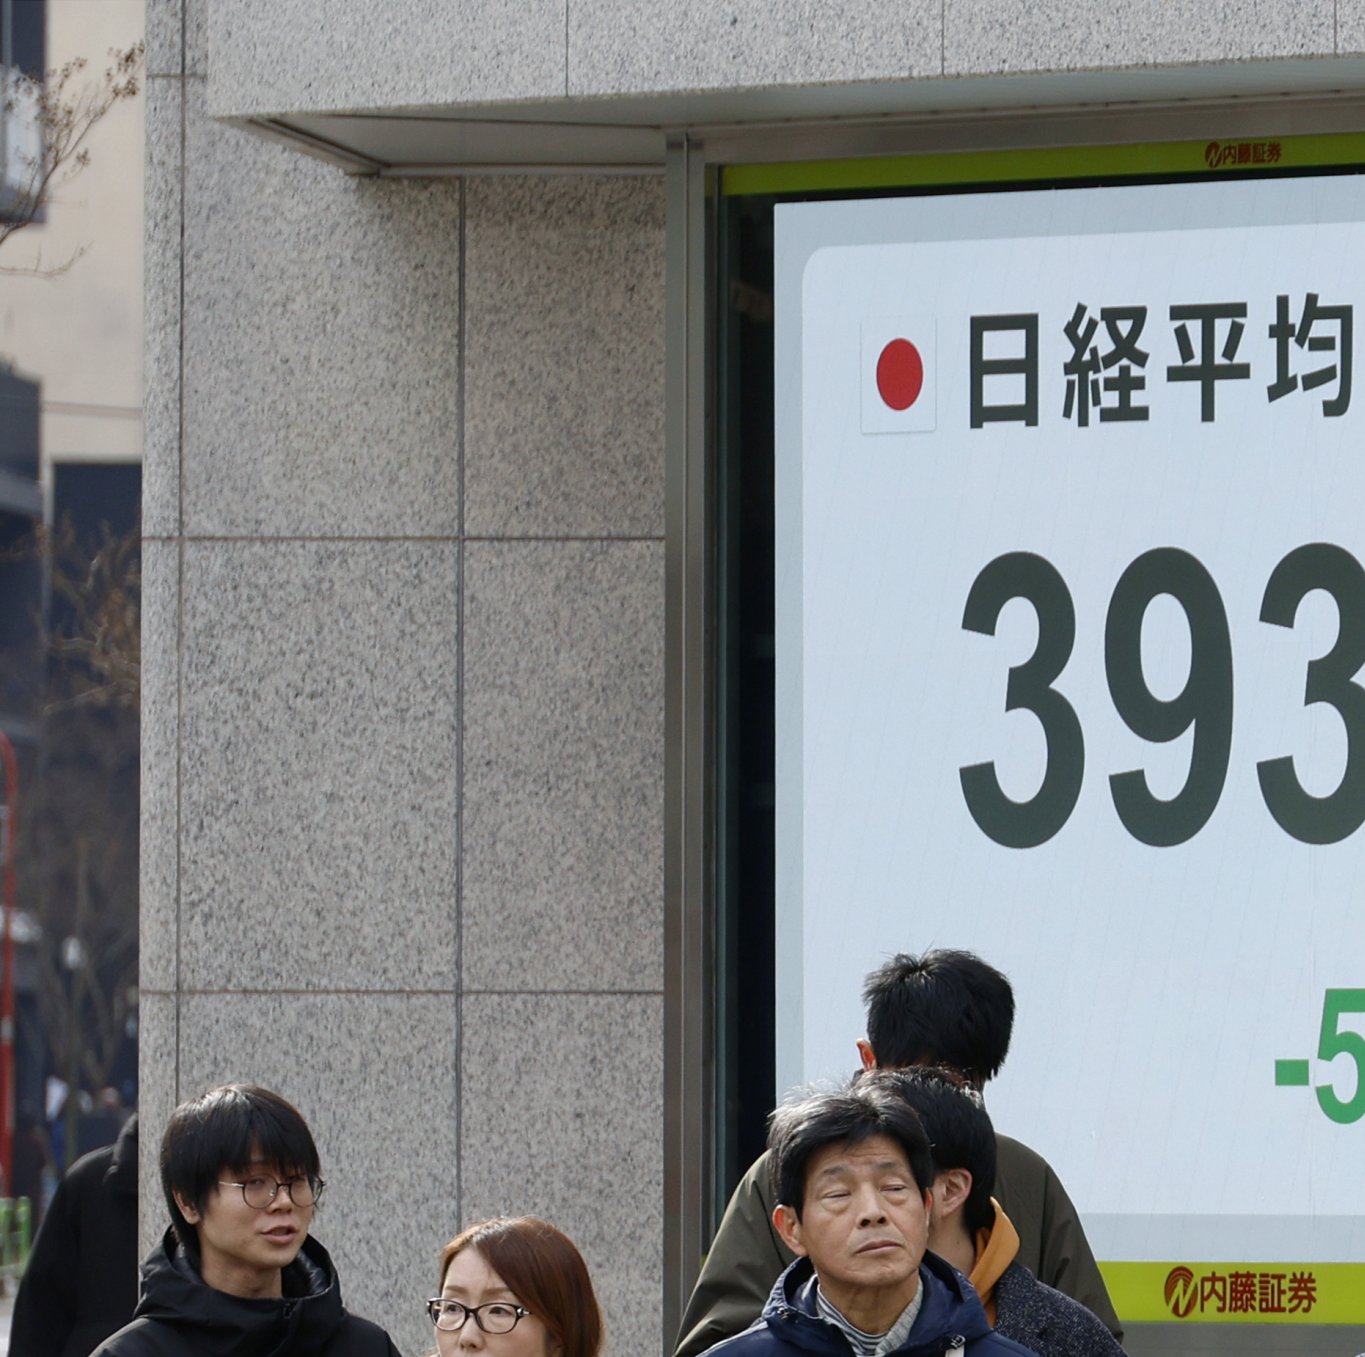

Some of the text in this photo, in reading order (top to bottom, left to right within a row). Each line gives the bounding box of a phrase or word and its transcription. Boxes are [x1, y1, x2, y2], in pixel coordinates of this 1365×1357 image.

[1225, 143, 1280, 163] 内藤証券
[970, 293, 1352, 429] 日経平均
[1201, 1272, 1316, 1313] 内藤証券
